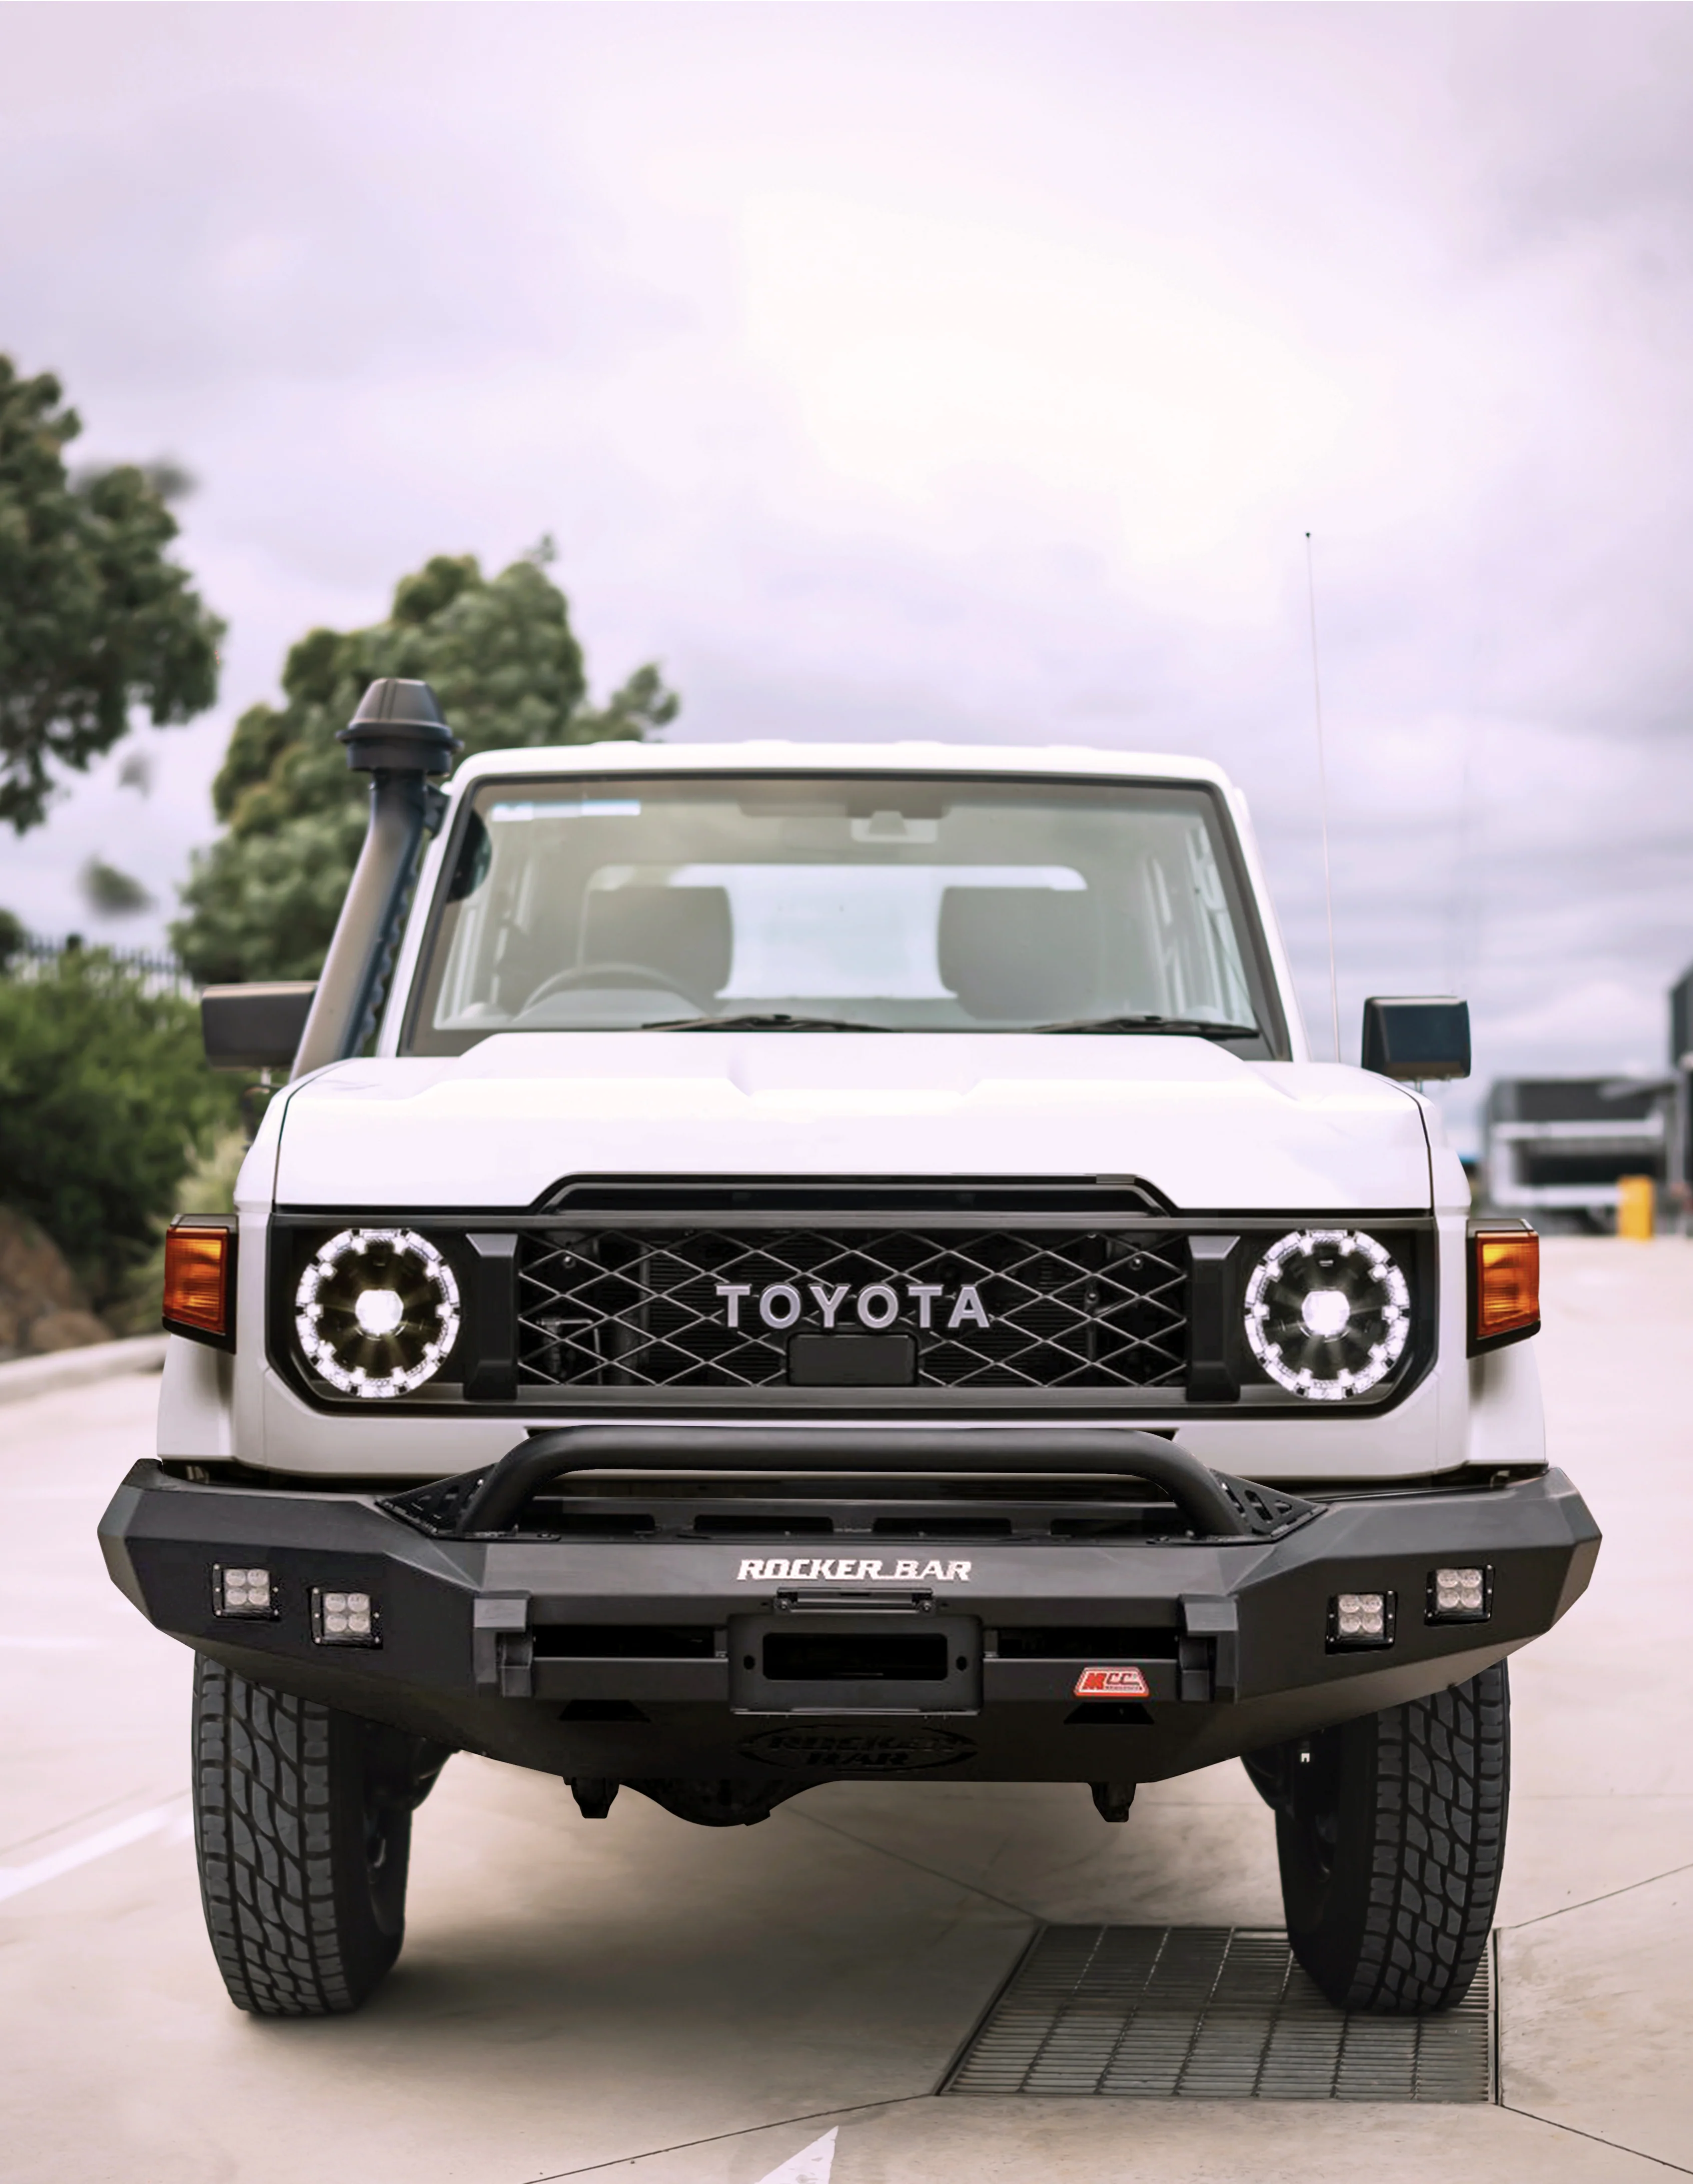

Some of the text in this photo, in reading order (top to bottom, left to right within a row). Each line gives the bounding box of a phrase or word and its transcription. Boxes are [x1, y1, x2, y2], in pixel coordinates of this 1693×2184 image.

[715, 1283, 990, 1329] TOYOTA
[737, 1559, 972, 1581] ROCKER BAR
